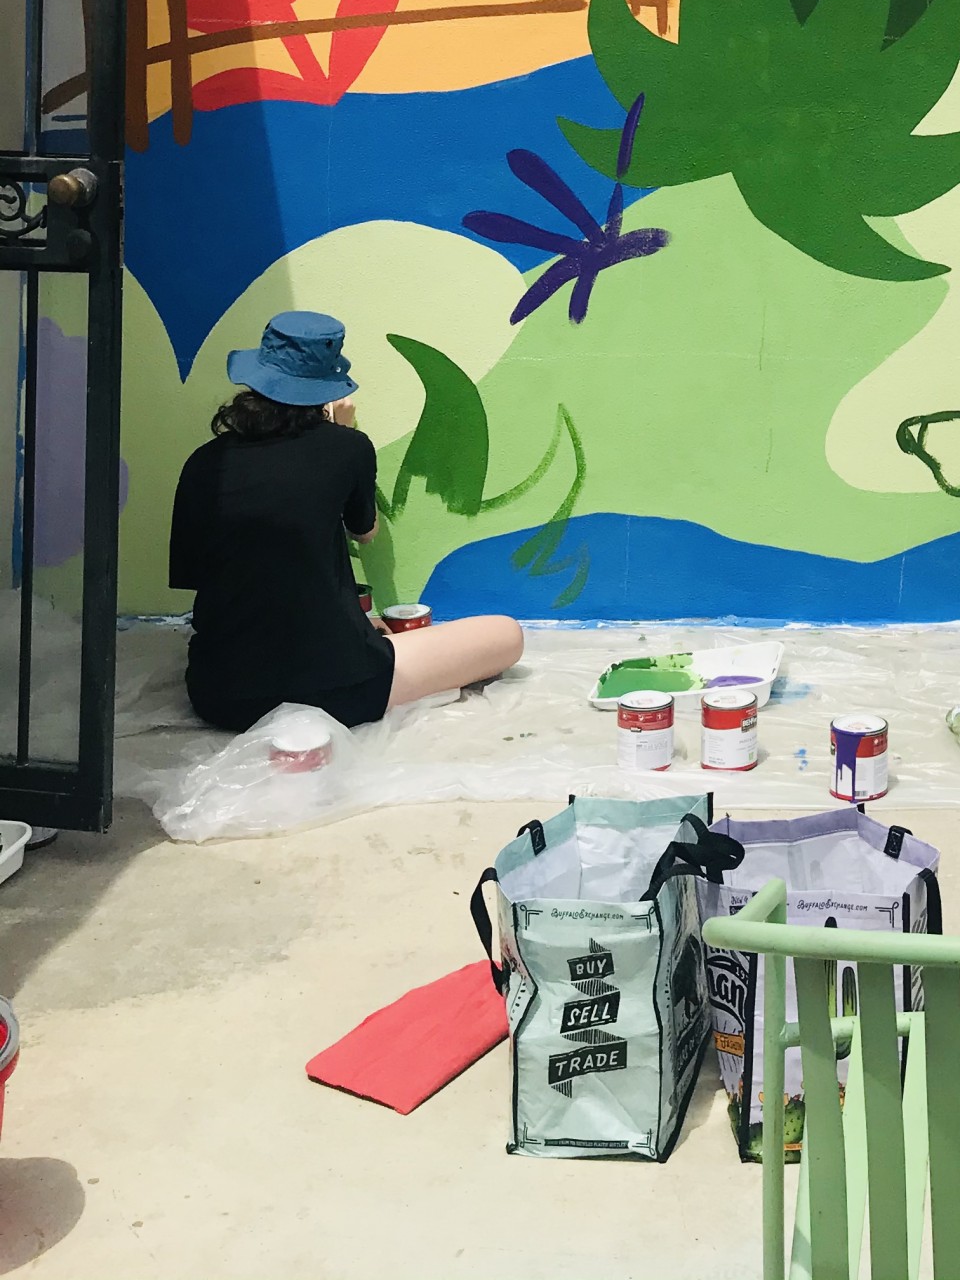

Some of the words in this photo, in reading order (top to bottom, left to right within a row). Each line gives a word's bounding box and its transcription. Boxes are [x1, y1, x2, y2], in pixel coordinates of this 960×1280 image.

[576, 959, 606, 975] BUY
[567, 1002, 610, 1026] SELL
[555, 1050, 620, 1076] TRADE
